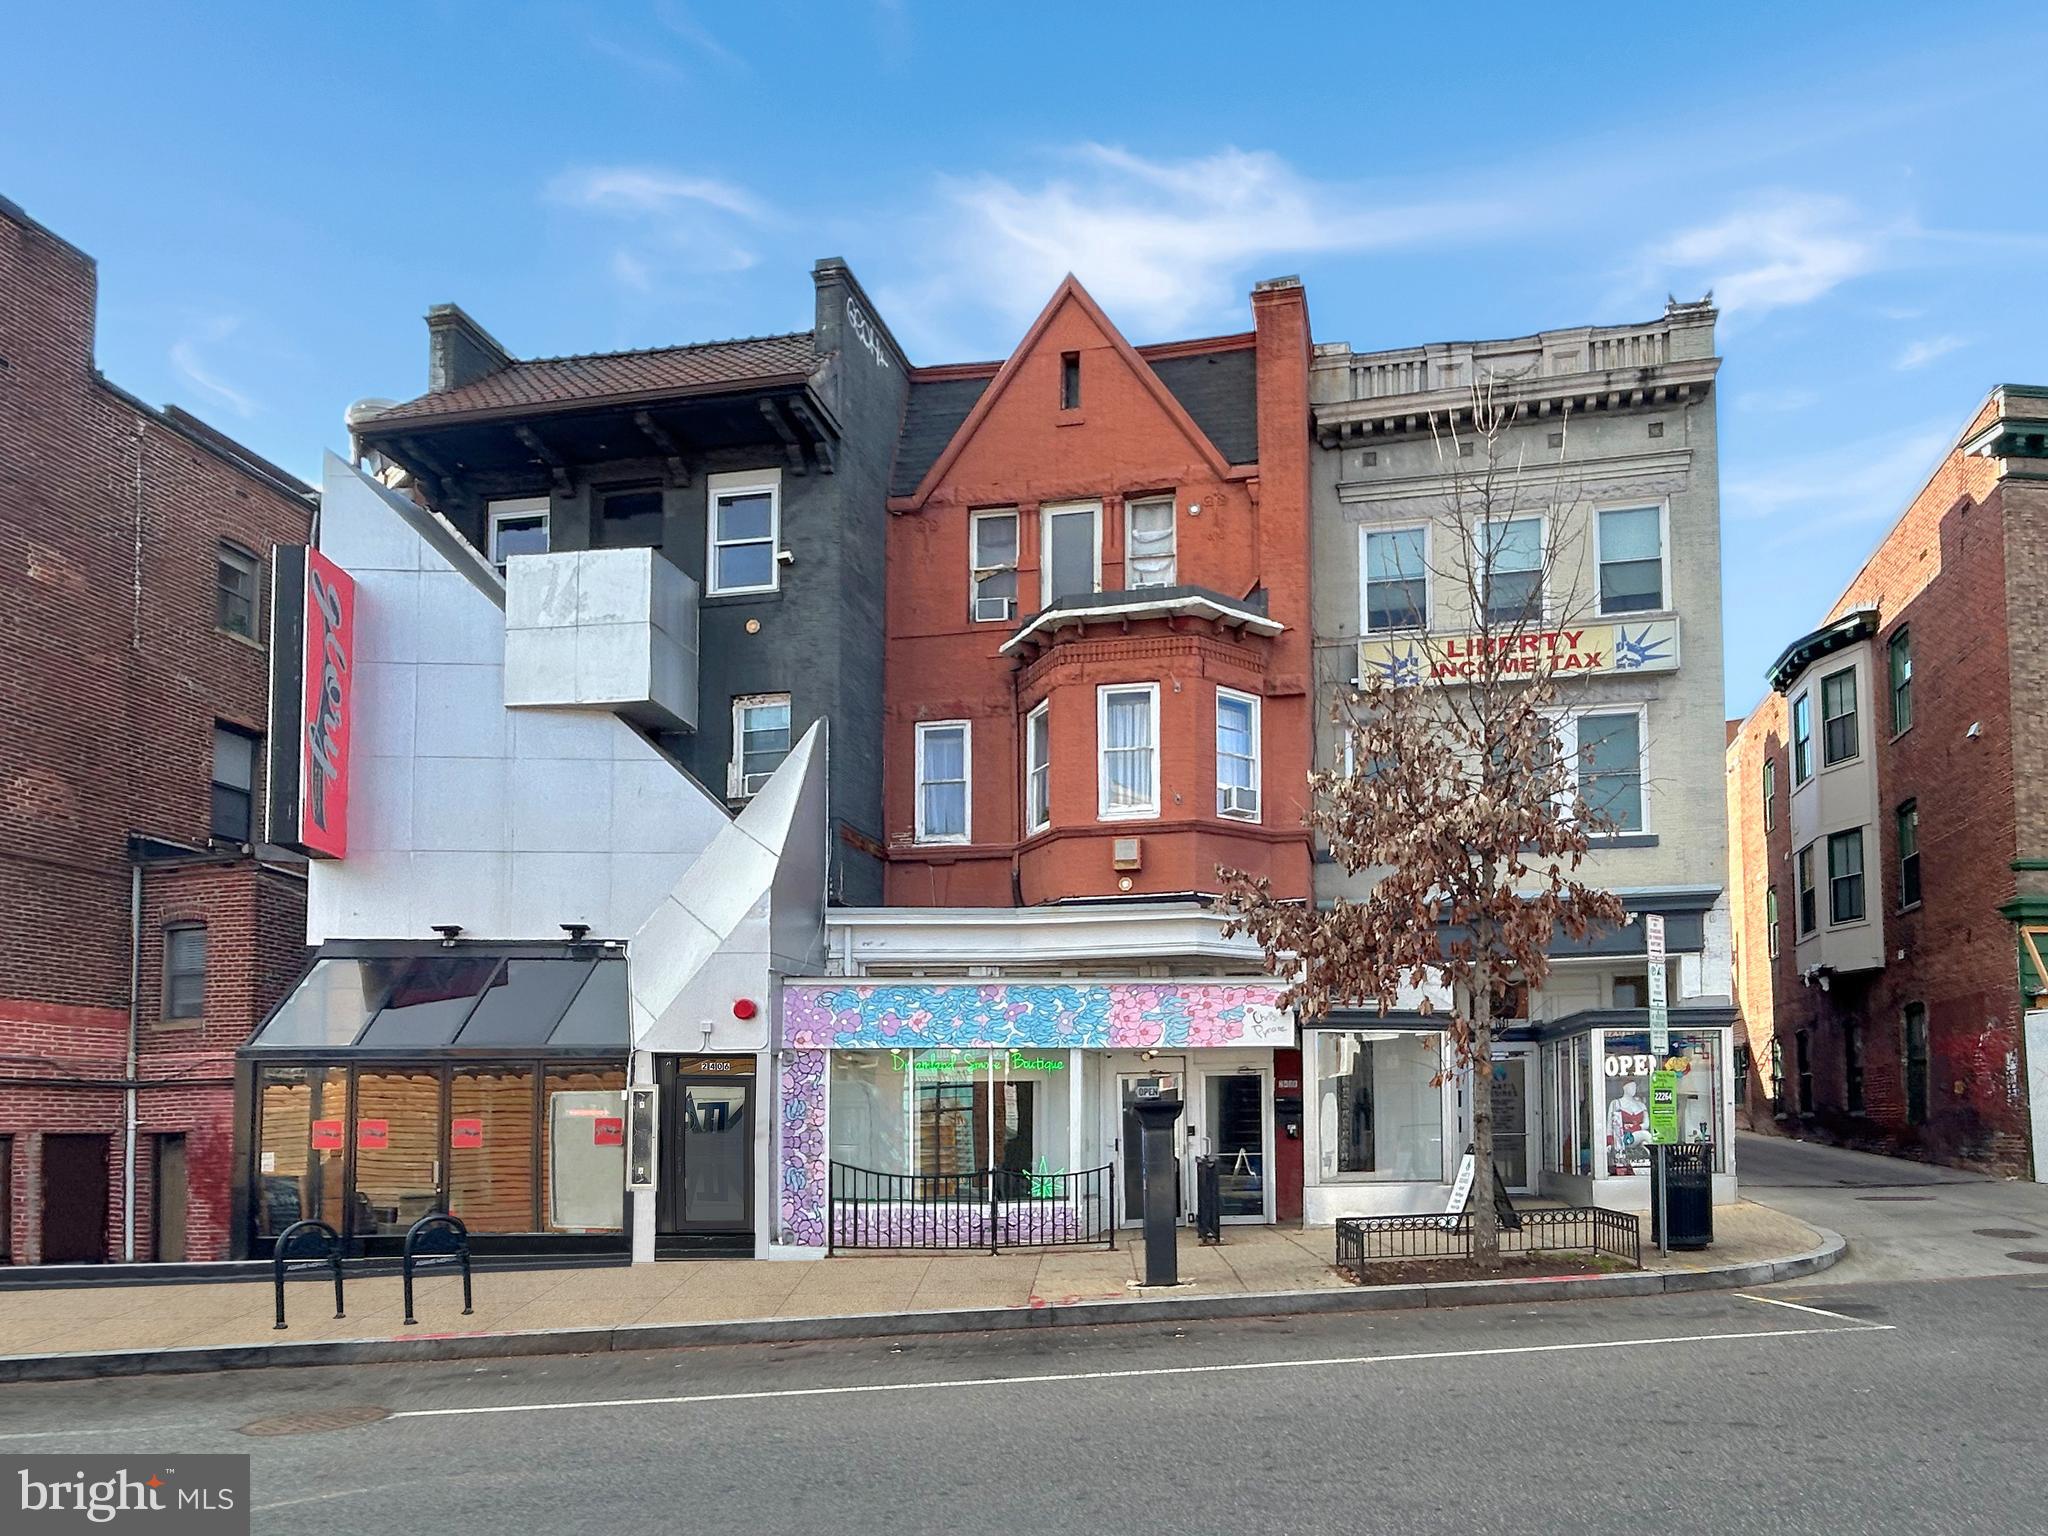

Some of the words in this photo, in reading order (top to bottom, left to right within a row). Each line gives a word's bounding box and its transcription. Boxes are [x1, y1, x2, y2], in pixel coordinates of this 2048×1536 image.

[1447, 631, 1584, 658] LIBERTY
[1547, 652, 1603, 671] TAX
[701, 1062, 731, 1071] 2406
[891, 1053, 957, 1072] Dramland
[963, 1053, 1002, 1073] Smoe
[1011, 1052, 1065, 1077] Boutique
[1138, 1087, 1159, 1097] OPEN
